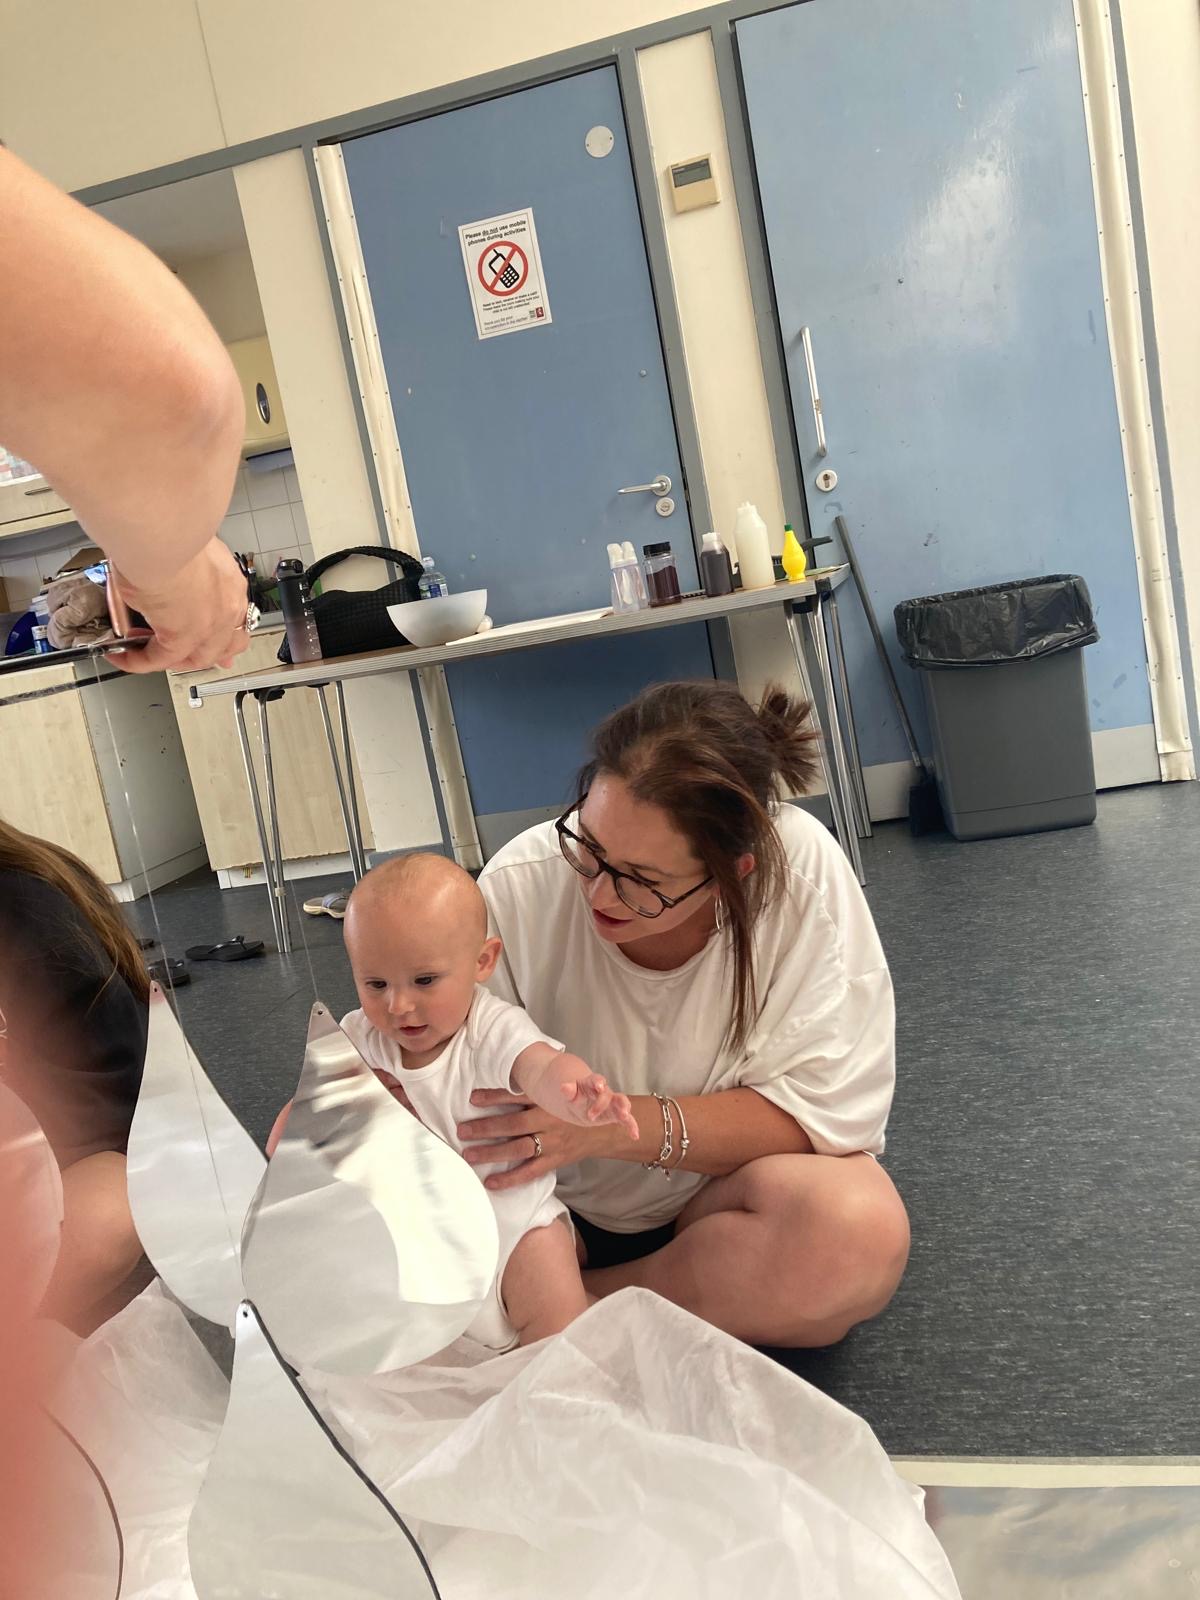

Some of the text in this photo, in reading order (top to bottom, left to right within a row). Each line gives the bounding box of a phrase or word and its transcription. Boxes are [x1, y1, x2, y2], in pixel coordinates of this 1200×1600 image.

[465, 232, 481, 240] Please
[508, 220, 526, 228] mobile
[468, 227, 526, 246] phones during activities
